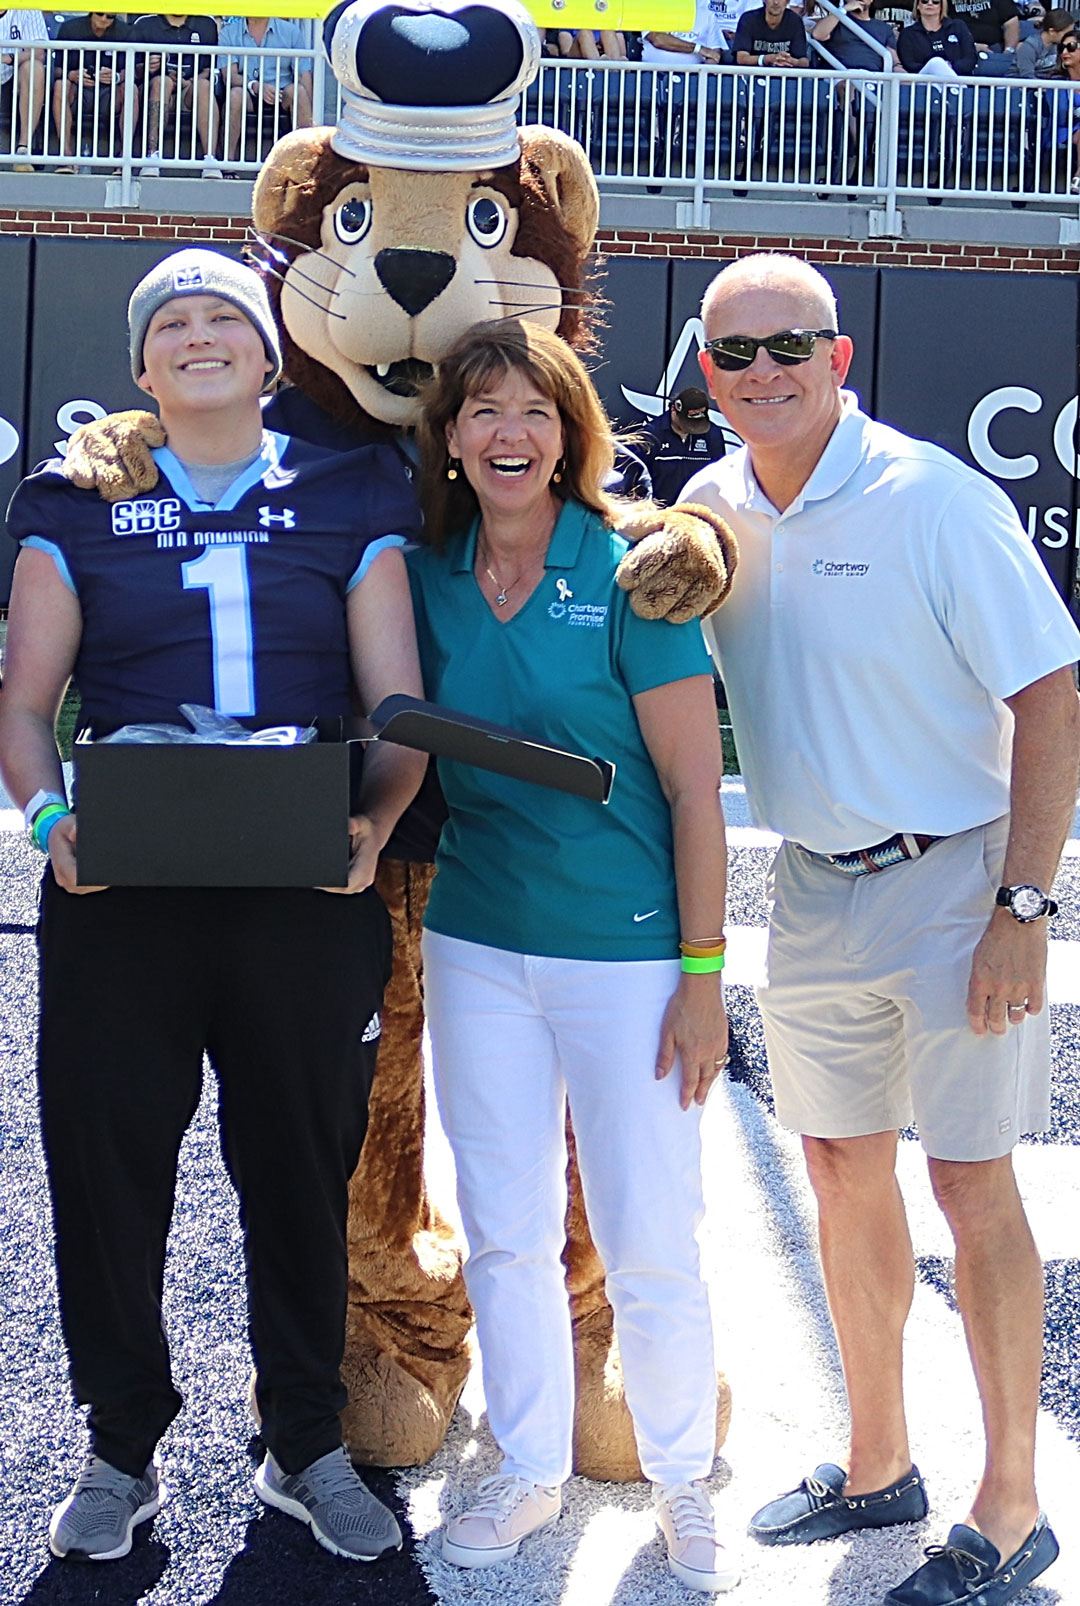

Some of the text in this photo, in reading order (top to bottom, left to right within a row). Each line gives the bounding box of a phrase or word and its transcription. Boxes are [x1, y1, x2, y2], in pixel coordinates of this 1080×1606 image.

[112, 498, 180, 535] SBC
[824, 562, 870, 575] Chartway
[567, 604, 609, 616] Chartway
[569, 613, 605, 623] Promise
[181, 543, 255, 716] 1
